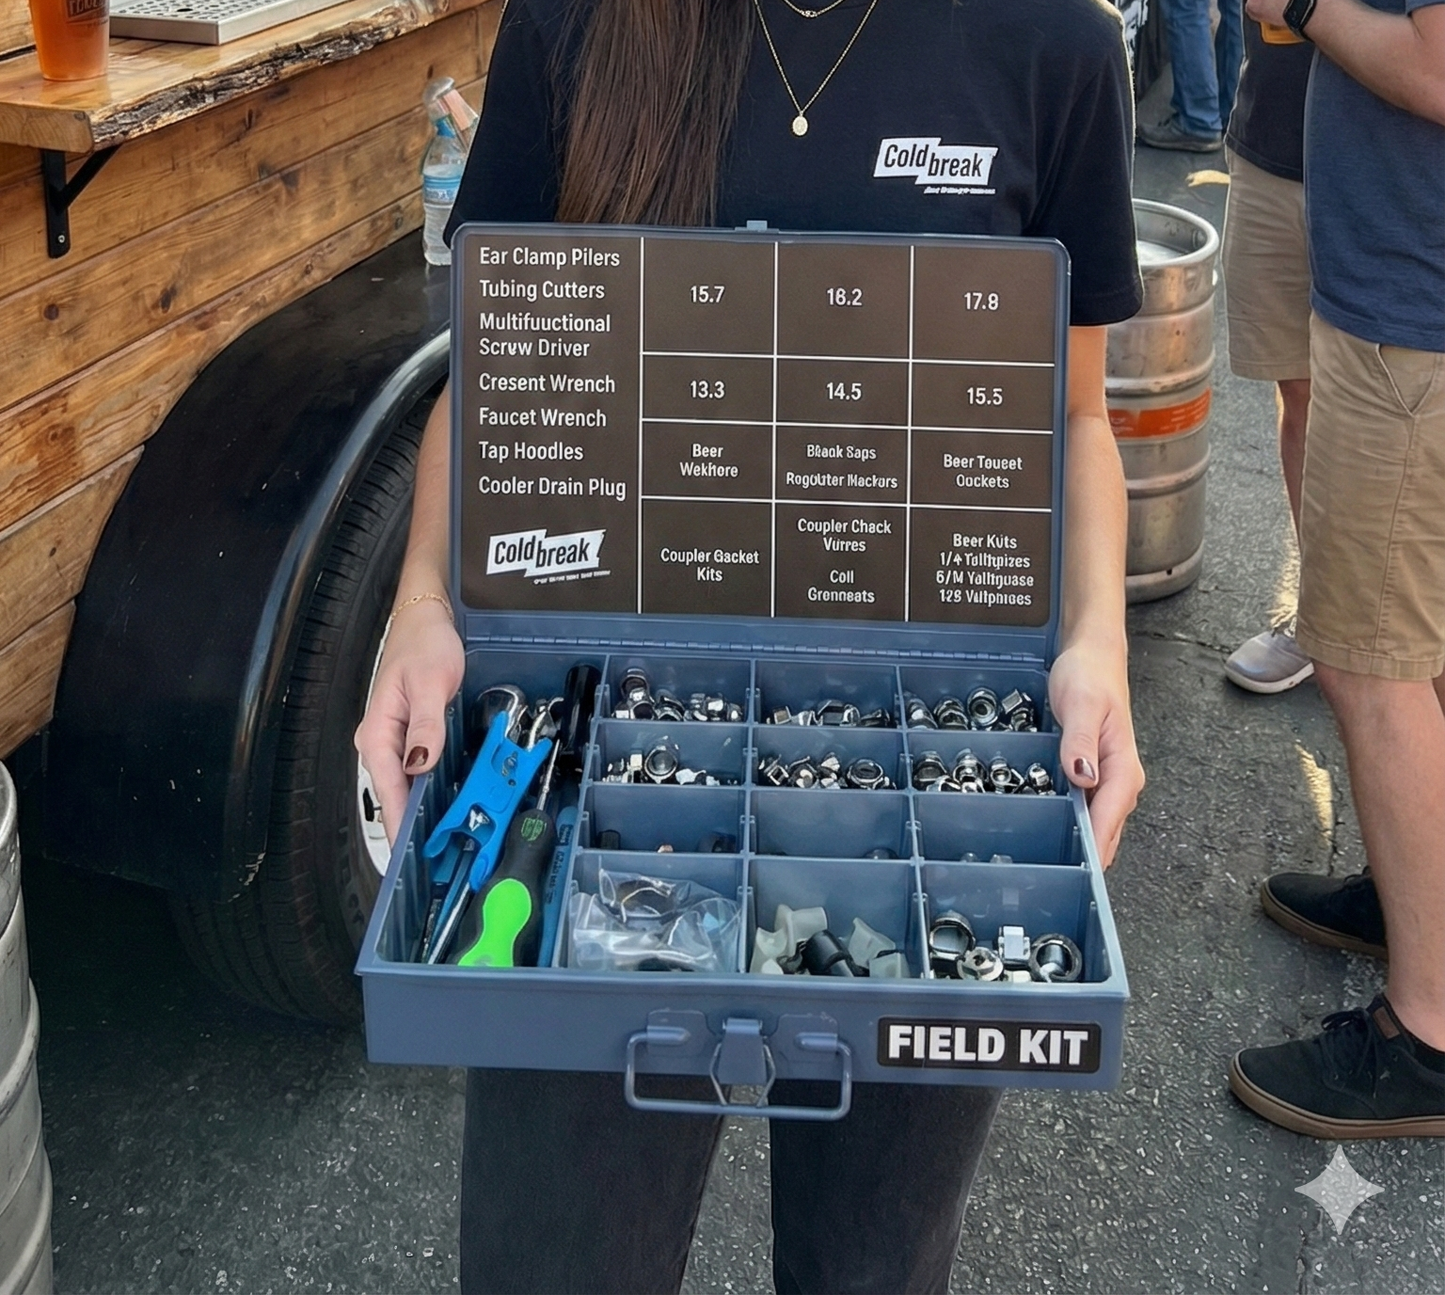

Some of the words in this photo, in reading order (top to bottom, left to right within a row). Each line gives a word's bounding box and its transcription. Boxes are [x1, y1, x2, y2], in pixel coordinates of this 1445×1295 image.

[479, 247, 508, 265] Ear
[513, 247, 567, 270] Clamp
[571, 247, 621, 266] Pilers
[479, 279, 537, 302] Tubing
[542, 280, 605, 299] Cutters
[690, 285, 725, 303] 15.7
[964, 292, 999, 310] 17.8
[538, 338, 590, 357] Driver
[479, 372, 546, 392] Cresent
[549, 374, 616, 393] Wrench
[690, 380, 725, 399] 13.3
[826, 382, 862, 400] 14.5
[967, 387, 1003, 405] 15.5
[479, 407, 537, 426] Faucet
[541, 408, 607, 427] Wrench
[478, 441, 509, 464] Tap
[514, 441, 584, 460] Hoodles
[692, 443, 724, 458] Beer
[943, 453, 975, 469] Beer
[478, 475, 534, 494] Cooler
[539, 477, 583, 495] Drain
[588, 477, 626, 502] Plug
[797, 518, 848, 535] Coupler
[851, 519, 892, 534] Chack
[953, 533, 984, 547] Beer
[660, 547, 712, 566] Coupler
[696, 566, 723, 582] Kits
[888, 1024, 1006, 1062] FIELD
[1019, 1028, 1089, 1066] KIT
